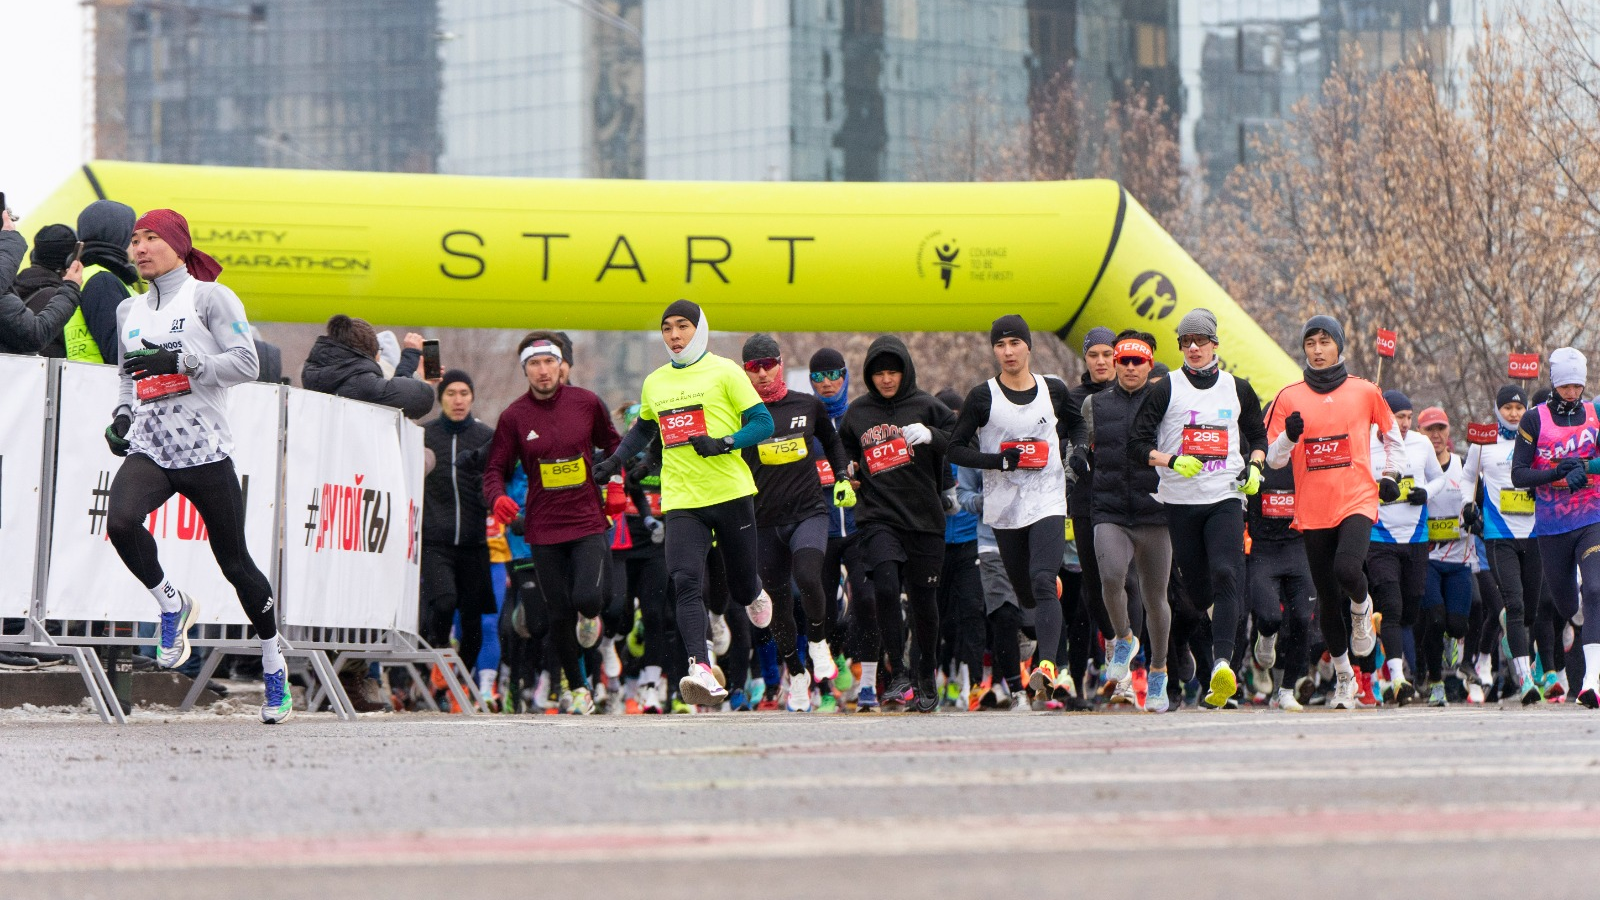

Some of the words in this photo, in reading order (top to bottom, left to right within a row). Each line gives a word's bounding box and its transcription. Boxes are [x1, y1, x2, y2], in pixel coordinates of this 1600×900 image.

[192, 229, 288, 243] LMATY
[439, 230, 815, 284] START
[1377, 336, 1395, 349] 0:40
[1509, 361, 1538, 371] 0:40
[666, 414, 694, 429] 362
[1193, 431, 1220, 443] 295
[1468, 428, 1497, 438] 0:40
[771, 441, 799, 454] 752
[872, 443, 895, 458] 671
[1312, 442, 1339, 455] 247
[552, 463, 580, 475] 863
[1269, 495, 1295, 506] 528
[1431, 521, 1454, 530] 802
